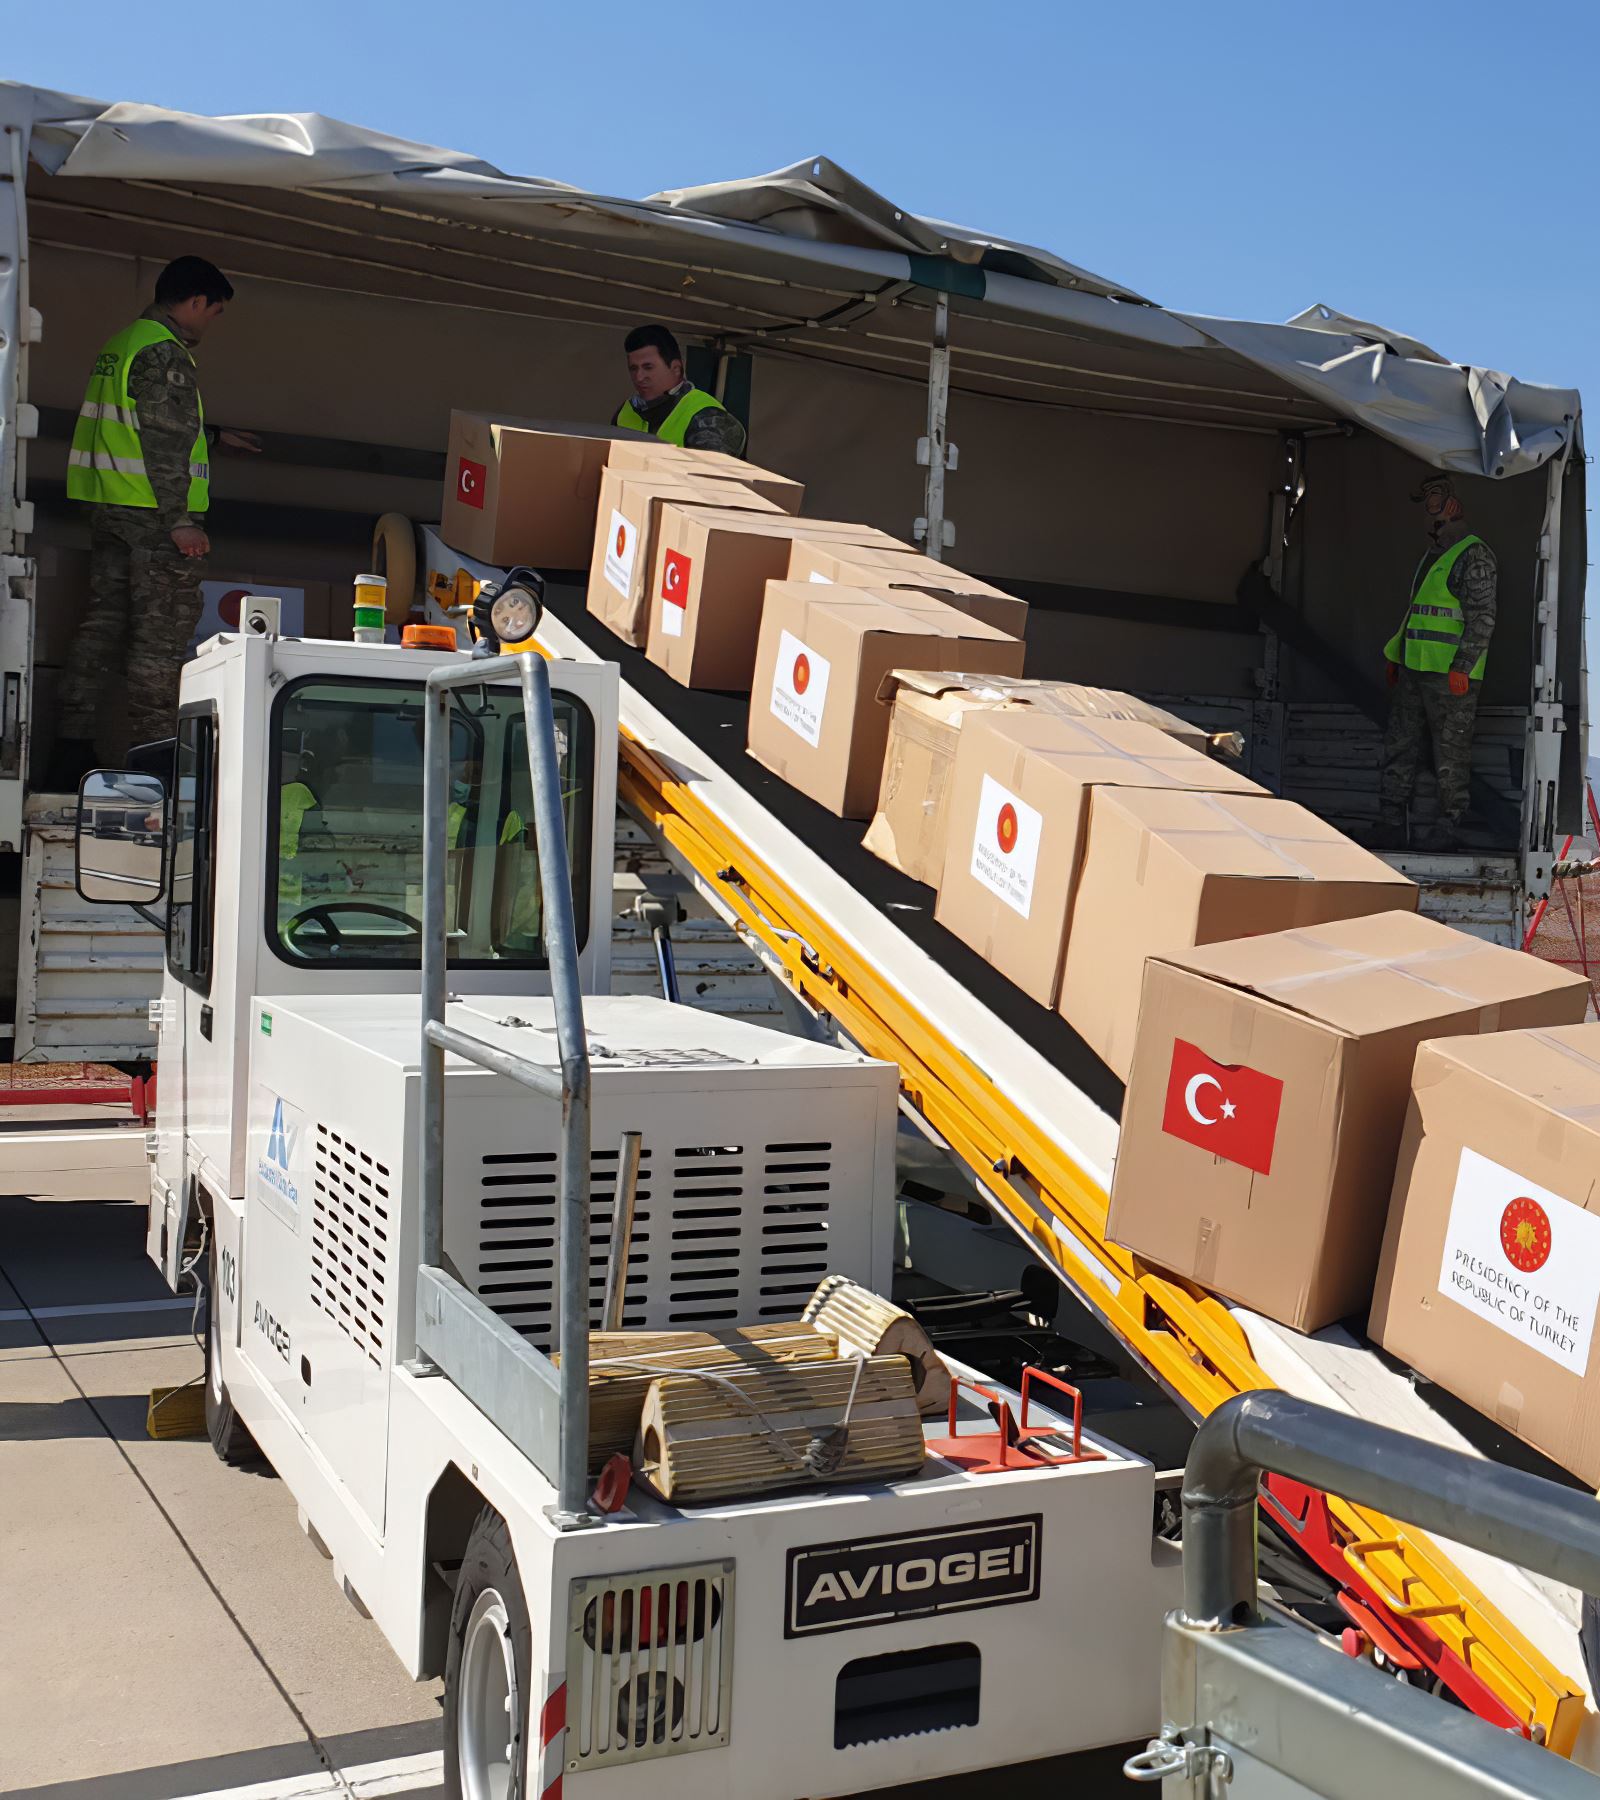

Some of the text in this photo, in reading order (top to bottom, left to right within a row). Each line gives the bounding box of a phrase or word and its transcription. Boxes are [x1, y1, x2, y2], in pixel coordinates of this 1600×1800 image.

[1451, 1270, 1576, 1353] REPUBLIC OF TURKEY
[1455, 1249, 1580, 1332] PRESIDENCY OF THE
[803, 1543, 1026, 1607] AVIOGEI
